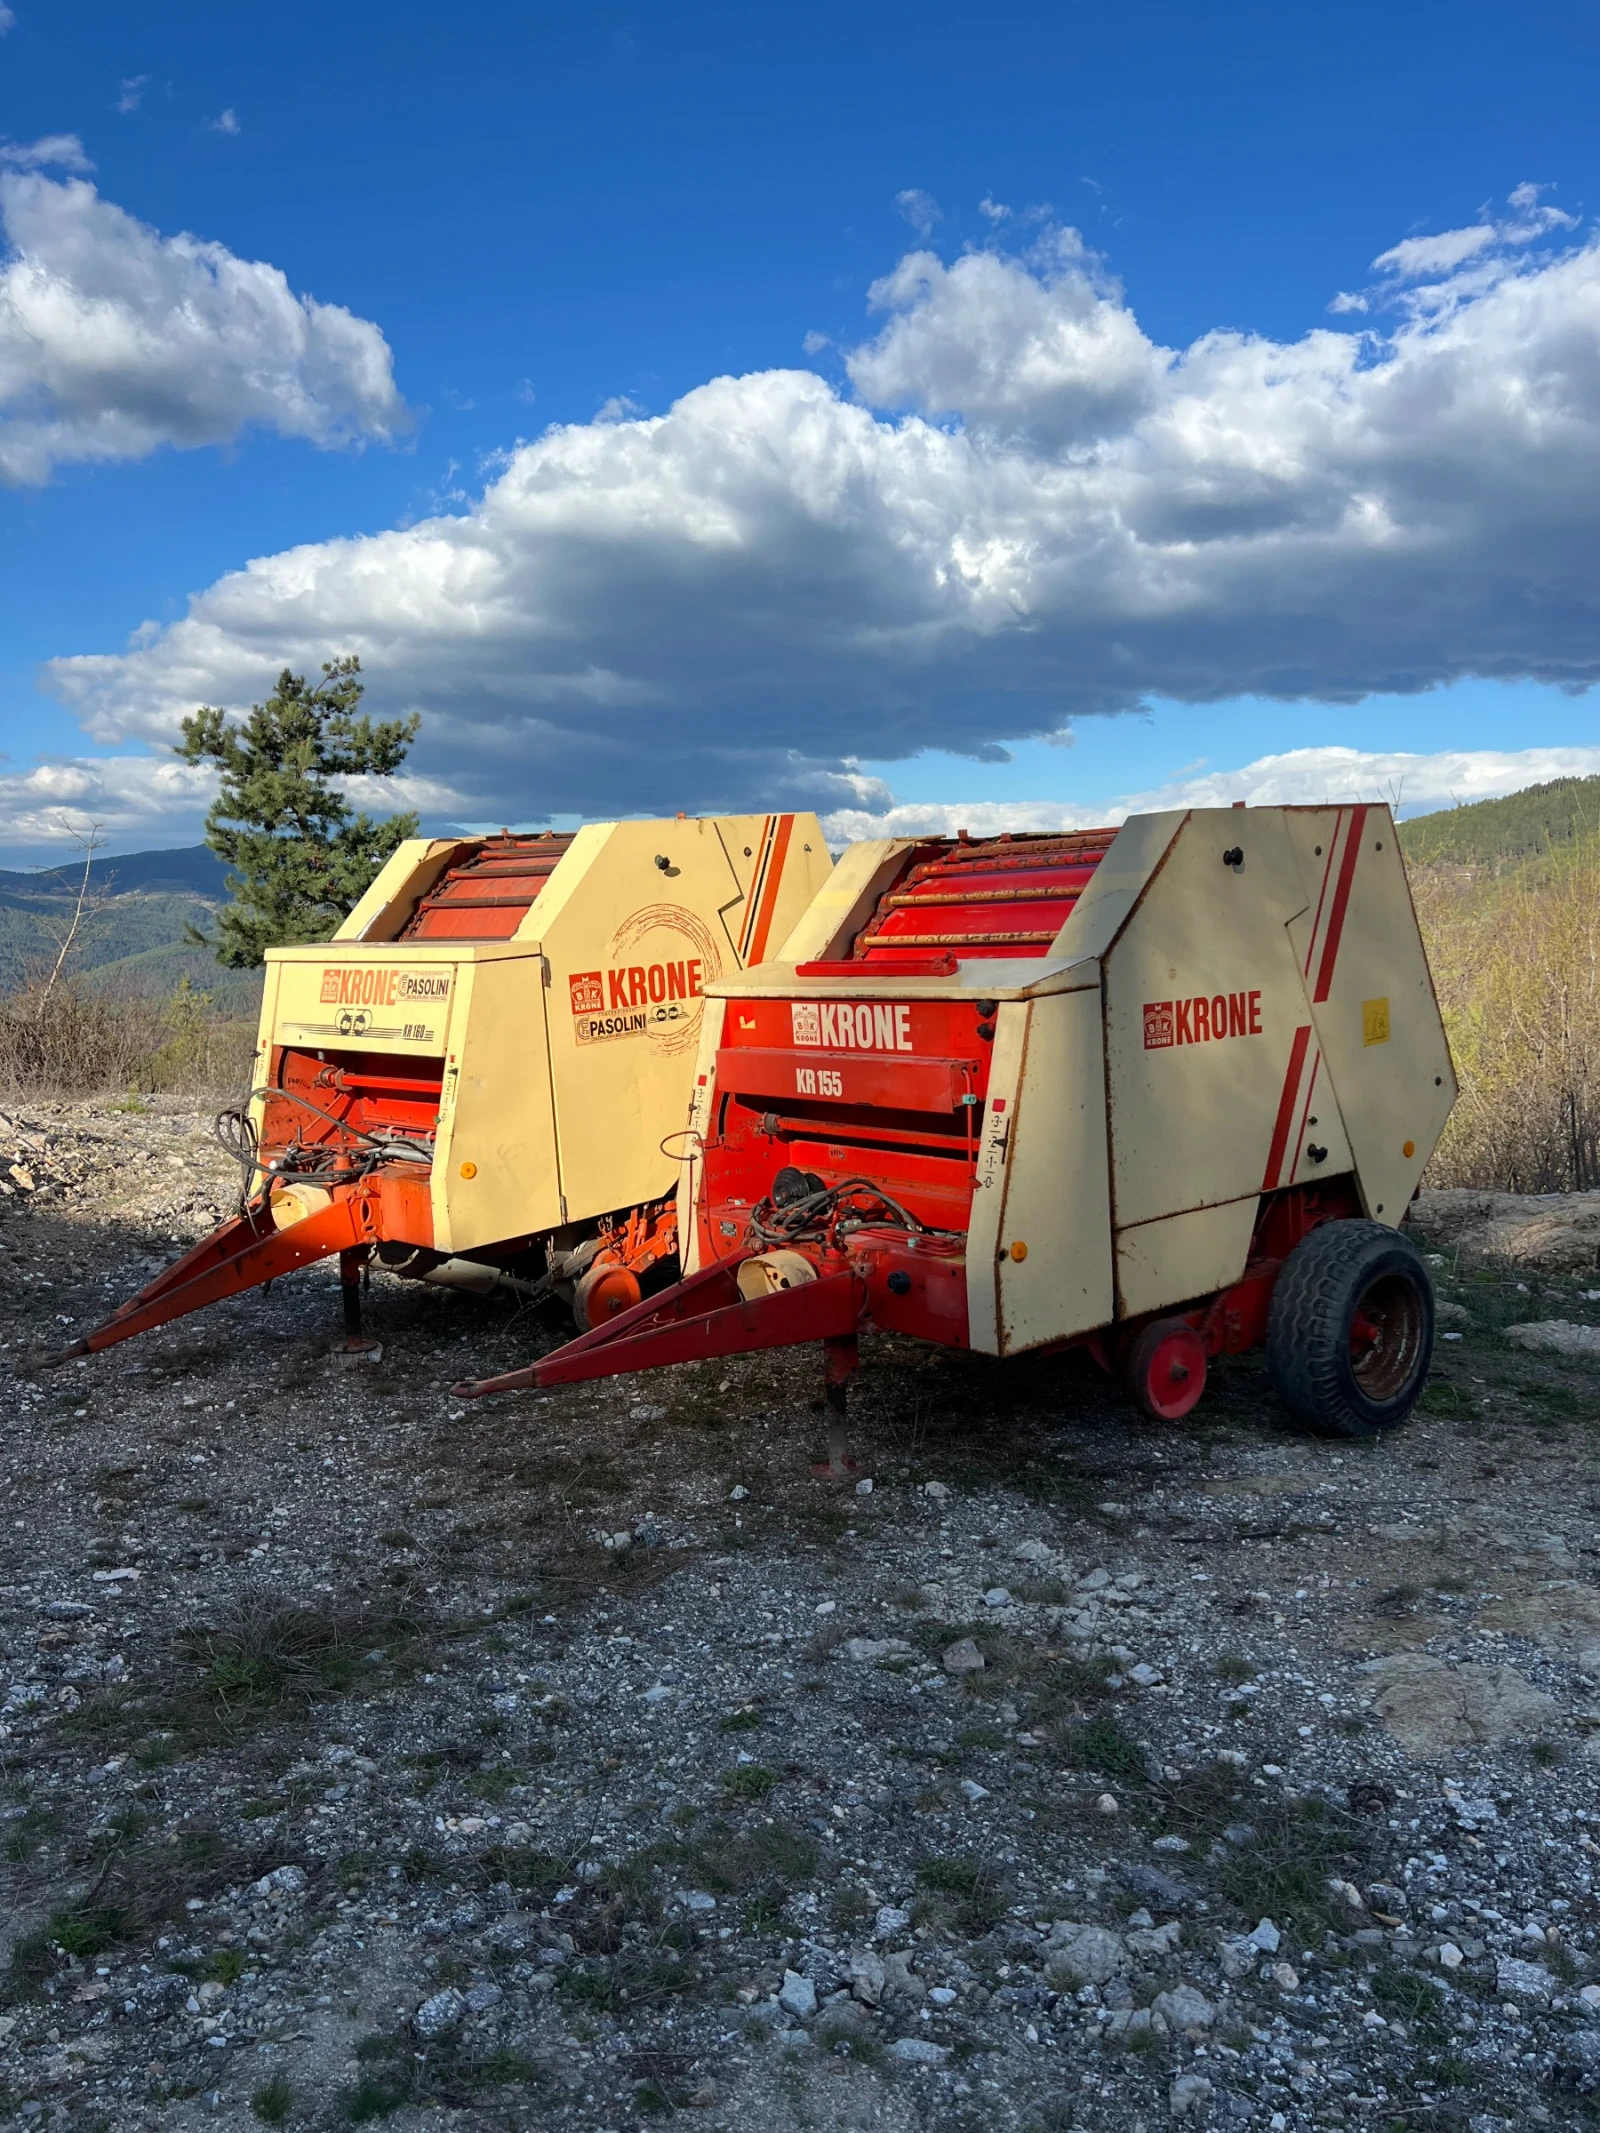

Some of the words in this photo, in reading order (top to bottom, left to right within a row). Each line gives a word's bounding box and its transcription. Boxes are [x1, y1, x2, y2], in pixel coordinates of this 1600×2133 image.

[338, 969, 399, 1005] KRONE
[406, 978, 449, 996] PASOLINI
[608, 959, 702, 1009] KRONE
[574, 1001, 602, 1011] KRONE
[1175, 990, 1262, 1045] KRONE
[402, 1024, 412, 1038] KR
[590, 1013, 647, 1037] PASOLINI
[820, 1004, 913, 1050] KRONE
[796, 1035, 818, 1043] KRONE
[1146, 1036, 1172, 1046] KRONE
[796, 1068, 816, 1094] KR
[817, 1069, 843, 1097] 155
